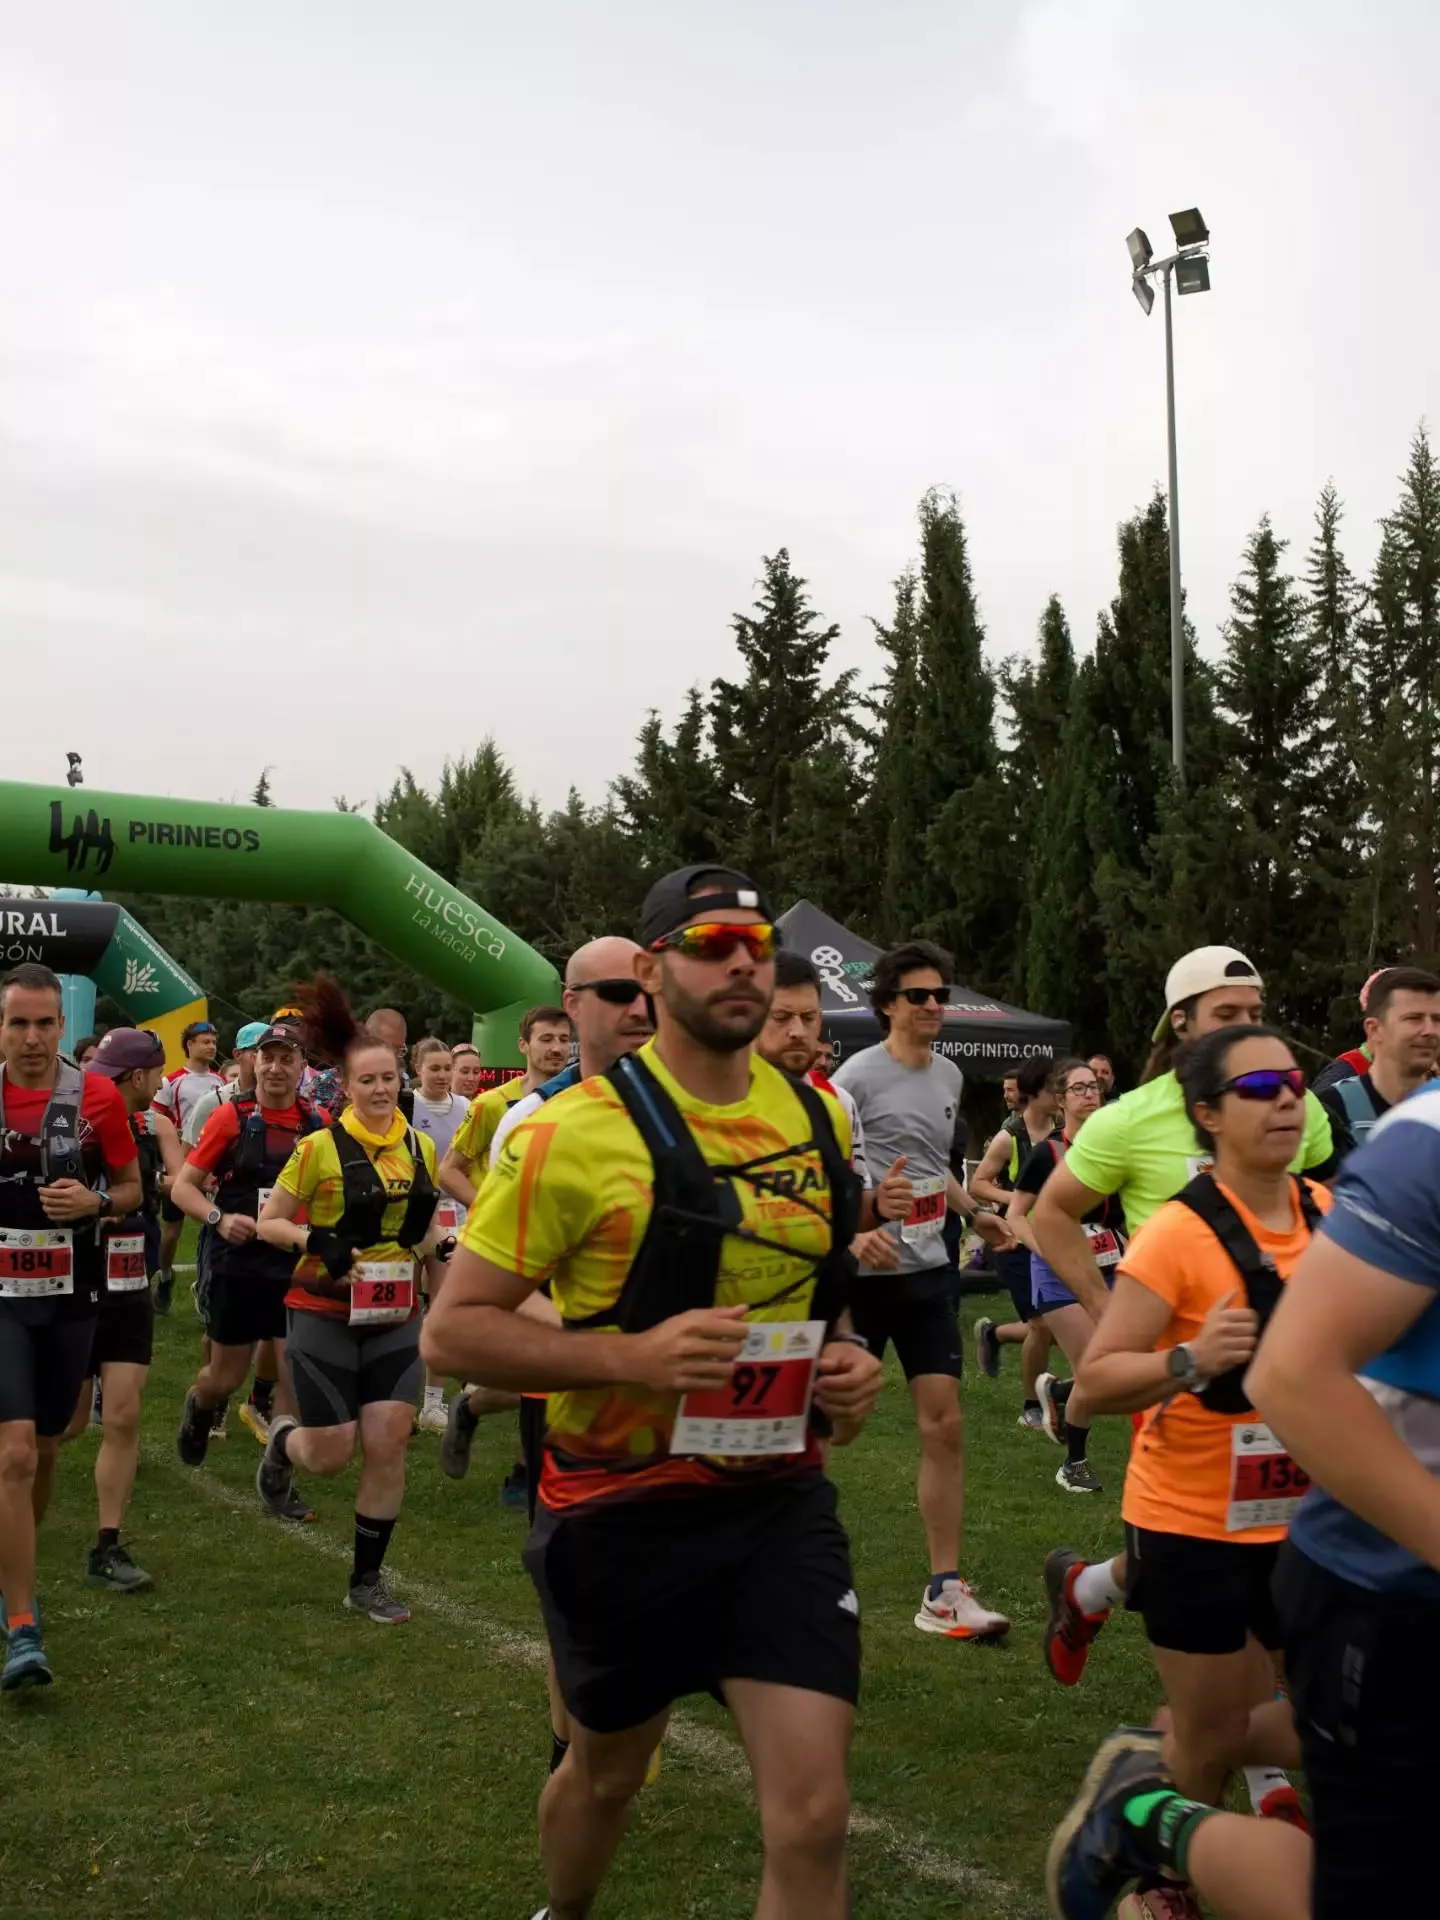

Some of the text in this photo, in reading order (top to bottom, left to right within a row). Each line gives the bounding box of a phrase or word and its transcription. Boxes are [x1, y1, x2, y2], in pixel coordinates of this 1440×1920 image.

[129, 820, 260, 852] PIRINEOS
[0, 911, 67, 937] RAL
[929, 1040, 1054, 1059] EMPOFINITO.COM
[9, 1250, 53, 1272] 184
[371, 1282, 397, 1303] 28
[732, 1366, 783, 1406] 97
